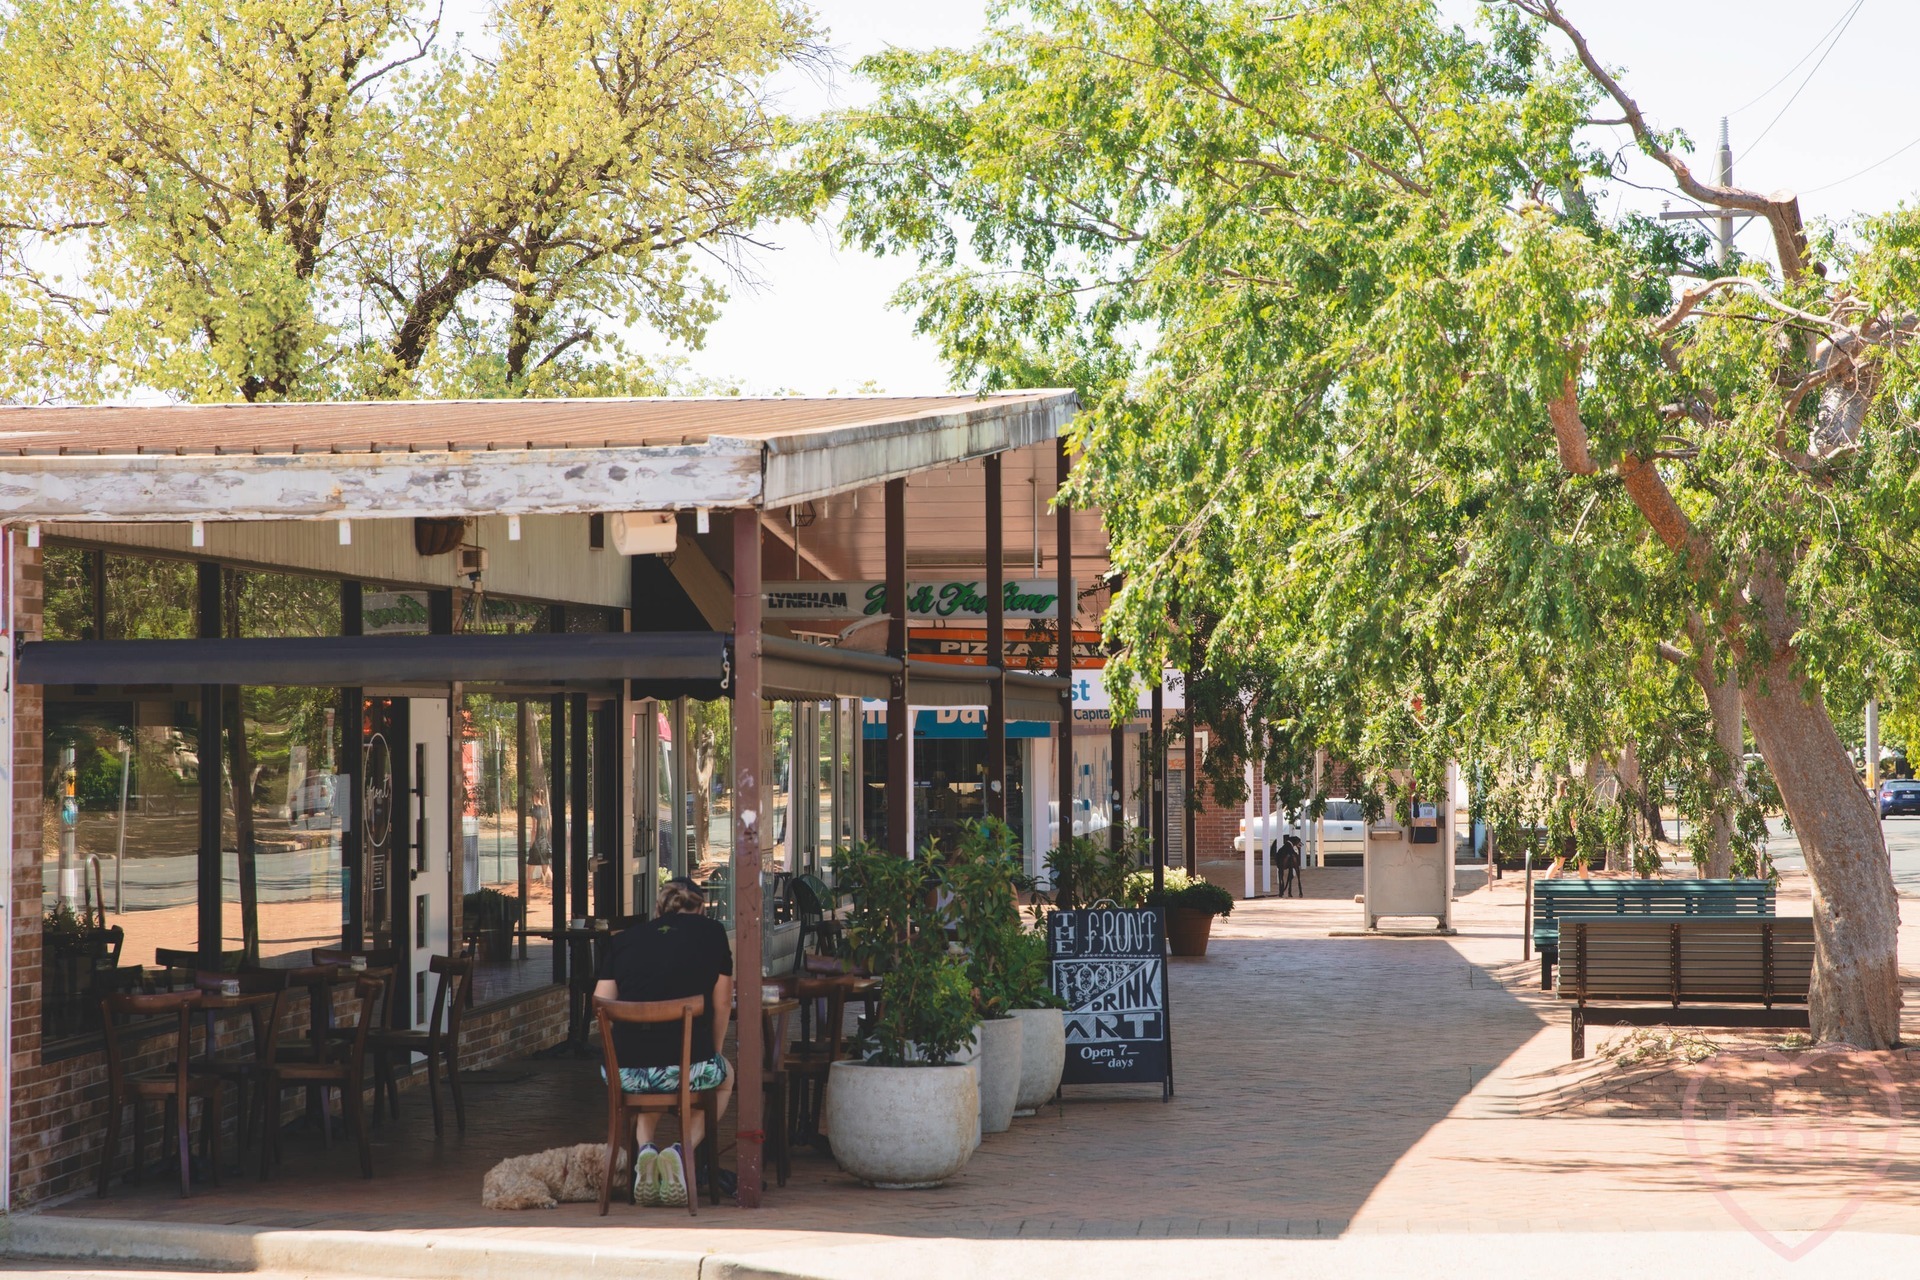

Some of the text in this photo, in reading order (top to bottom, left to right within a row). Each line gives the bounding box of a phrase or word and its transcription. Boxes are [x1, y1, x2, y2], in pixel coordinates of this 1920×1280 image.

[768, 582, 1057, 616] LYNEHAM Hir Fasions
[1074, 709, 1110, 721] Capita
[1084, 911, 1157, 953] FRONT
[1092, 960, 1160, 1012] DRINK
[1064, 1014, 1155, 1039] ART
[1080, 1044, 1128, 1060] Open 7
[1108, 1056, 1134, 1069] days
